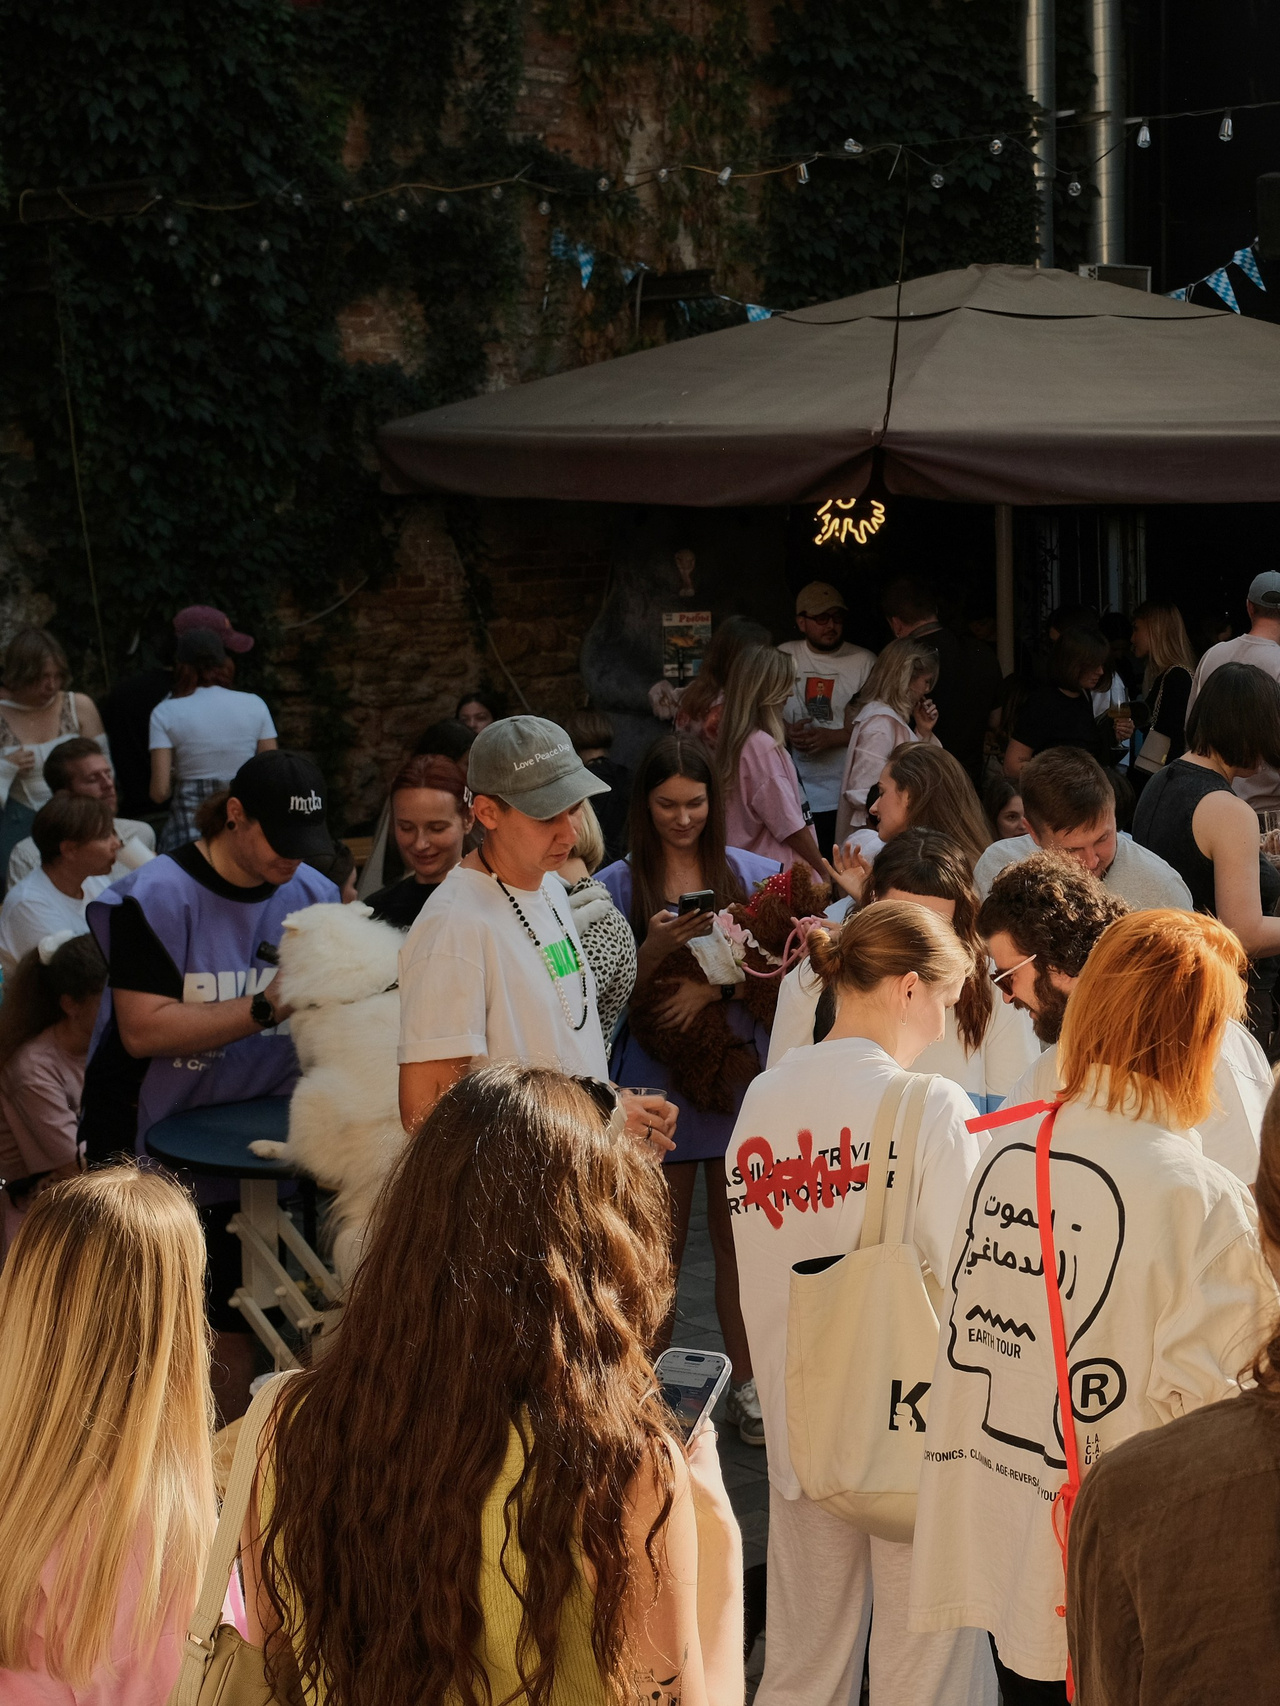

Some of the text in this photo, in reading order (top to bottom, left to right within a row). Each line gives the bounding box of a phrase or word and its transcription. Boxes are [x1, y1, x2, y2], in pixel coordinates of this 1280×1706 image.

[679, 613, 709, 623] Рыбы
[513, 758, 535, 772] Love
[534, 748, 559, 763] Peace
[968, 1328, 1021, 1359] EARTH TOUR
